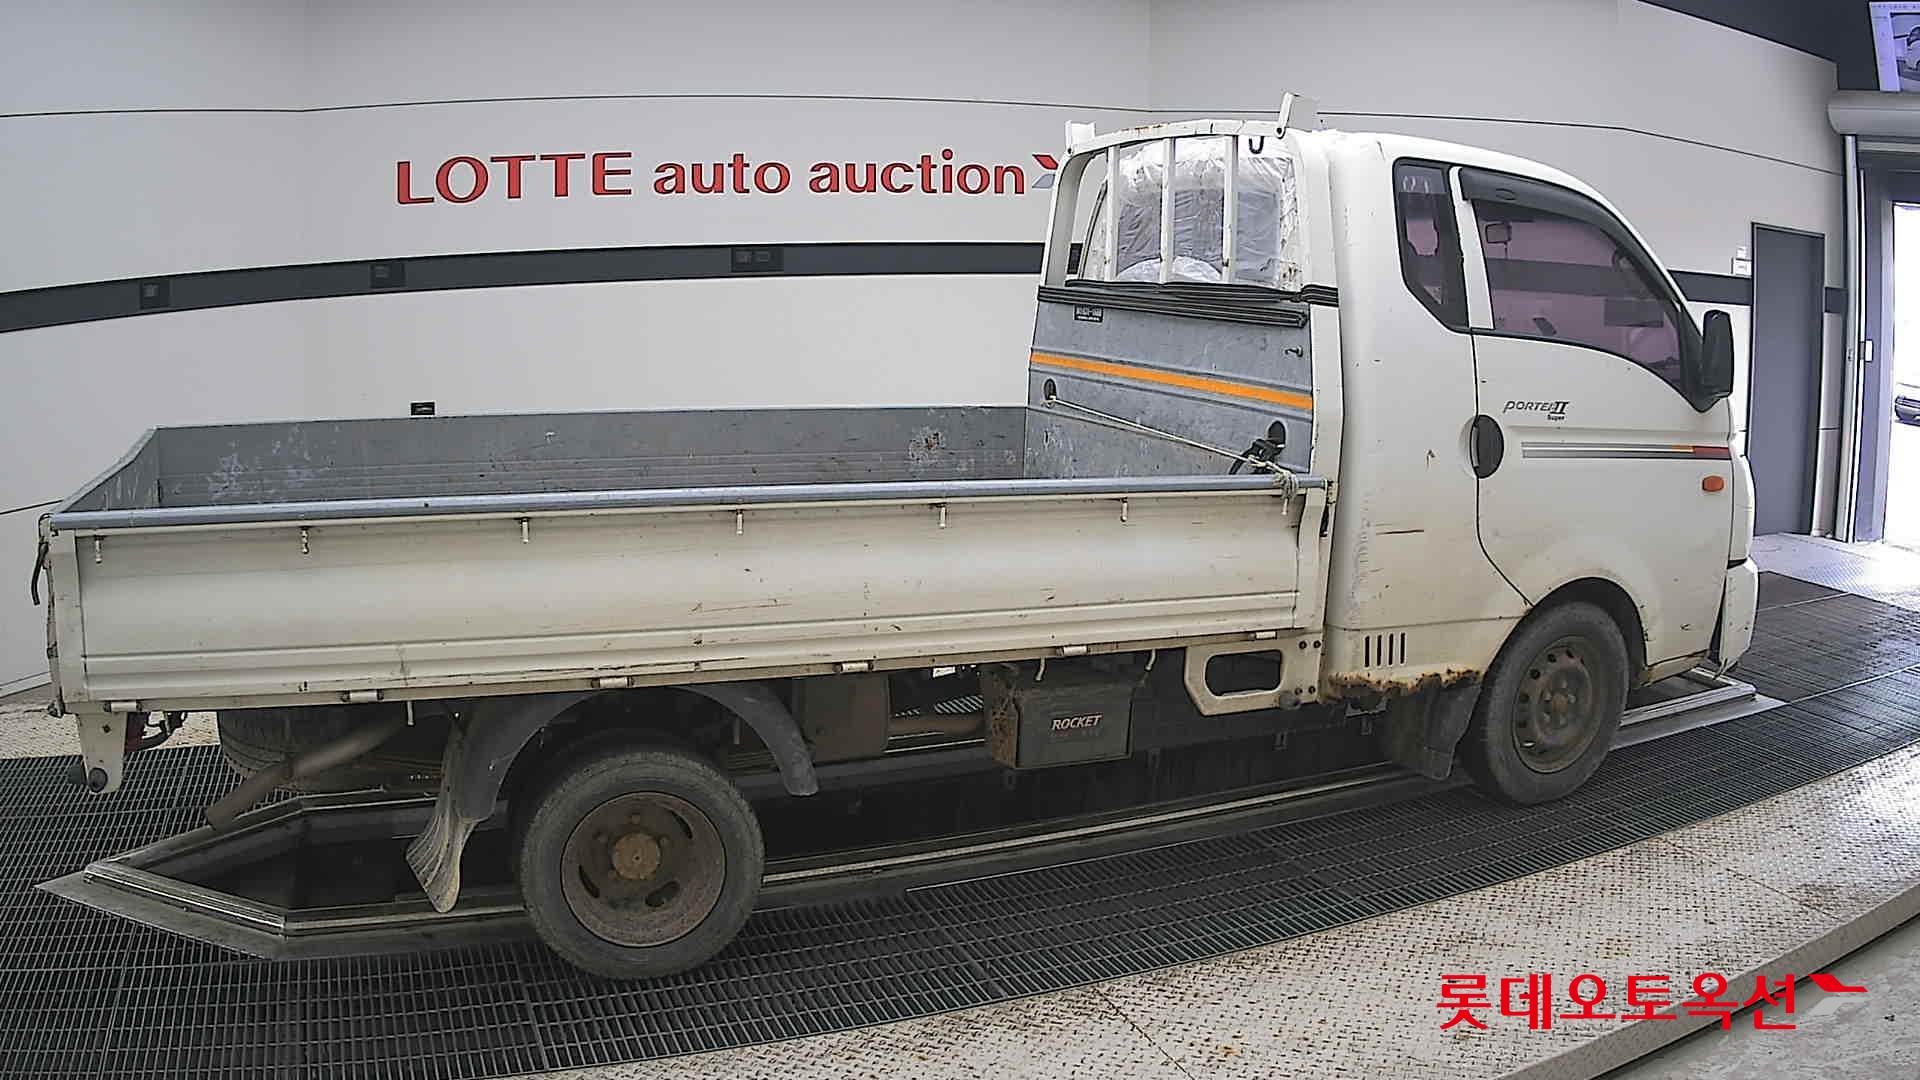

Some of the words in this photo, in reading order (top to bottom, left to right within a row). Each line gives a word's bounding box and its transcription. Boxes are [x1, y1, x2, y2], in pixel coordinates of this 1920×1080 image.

[398, 152, 631, 204] LOTTE
[655, 154, 791, 194] auto
[809, 149, 1025, 195] auction
[1051, 715, 1102, 730] ROCKET
